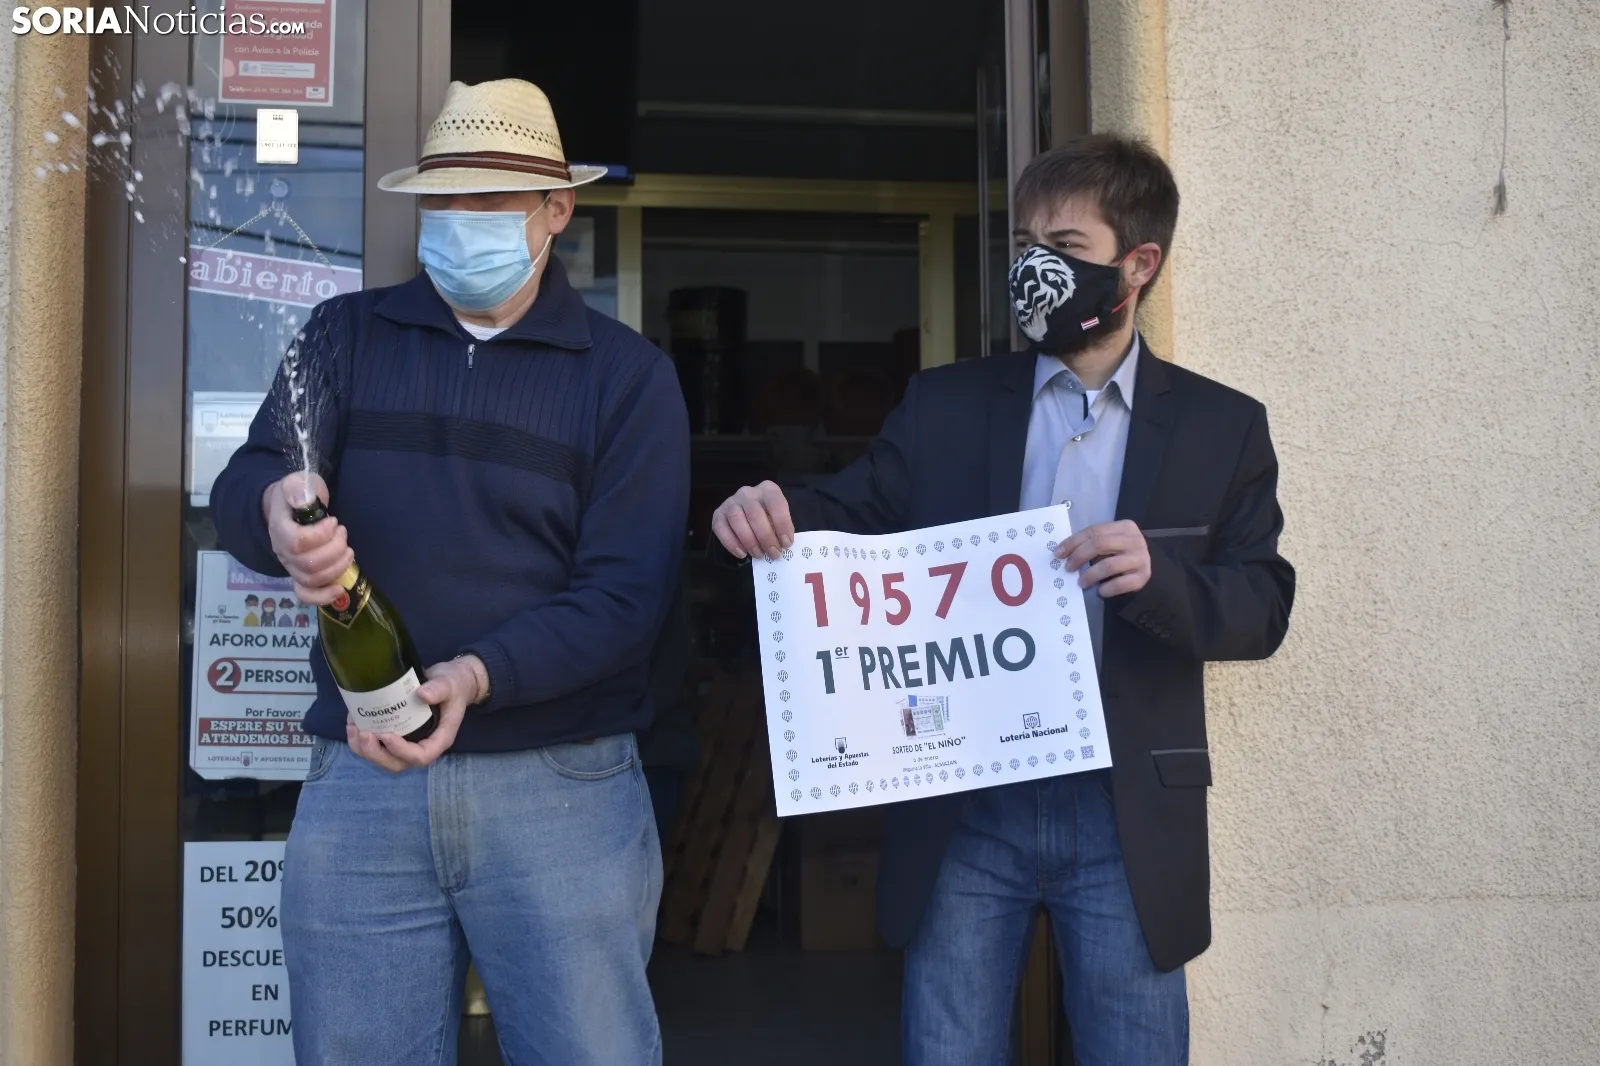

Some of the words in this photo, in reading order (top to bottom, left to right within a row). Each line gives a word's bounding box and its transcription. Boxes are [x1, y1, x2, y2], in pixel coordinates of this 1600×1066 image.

[234, 46, 250, 54] con
[252, 45, 274, 55] Aviso
[190, 257, 338, 299] abierto
[804, 553, 1034, 628] 19570
[209, 633, 268, 648] AFORO
[858, 627, 1036, 691] PREMIO
[215, 661, 234, 687] 2
[245, 707, 264, 718] Por
[266, 708, 301, 718] Favor:
[210, 720, 263, 732] ESPERE
[265, 721, 285, 732] SU
[1031, 724, 1069, 738] Nacional
[200, 732, 289, 745] ATENDEMOS
[844, 752, 870, 760] Apuestas
[891, 745, 914, 755] SORTEO
[914, 744, 923, 753] DE
[827, 761, 838, 769] del
[838, 760, 859, 768] Estado
[200, 866, 238, 883] DEL
[221, 905, 278, 929] 50%
[252, 984, 279, 1001] EN
[209, 1018, 292, 1037] PERFUM
